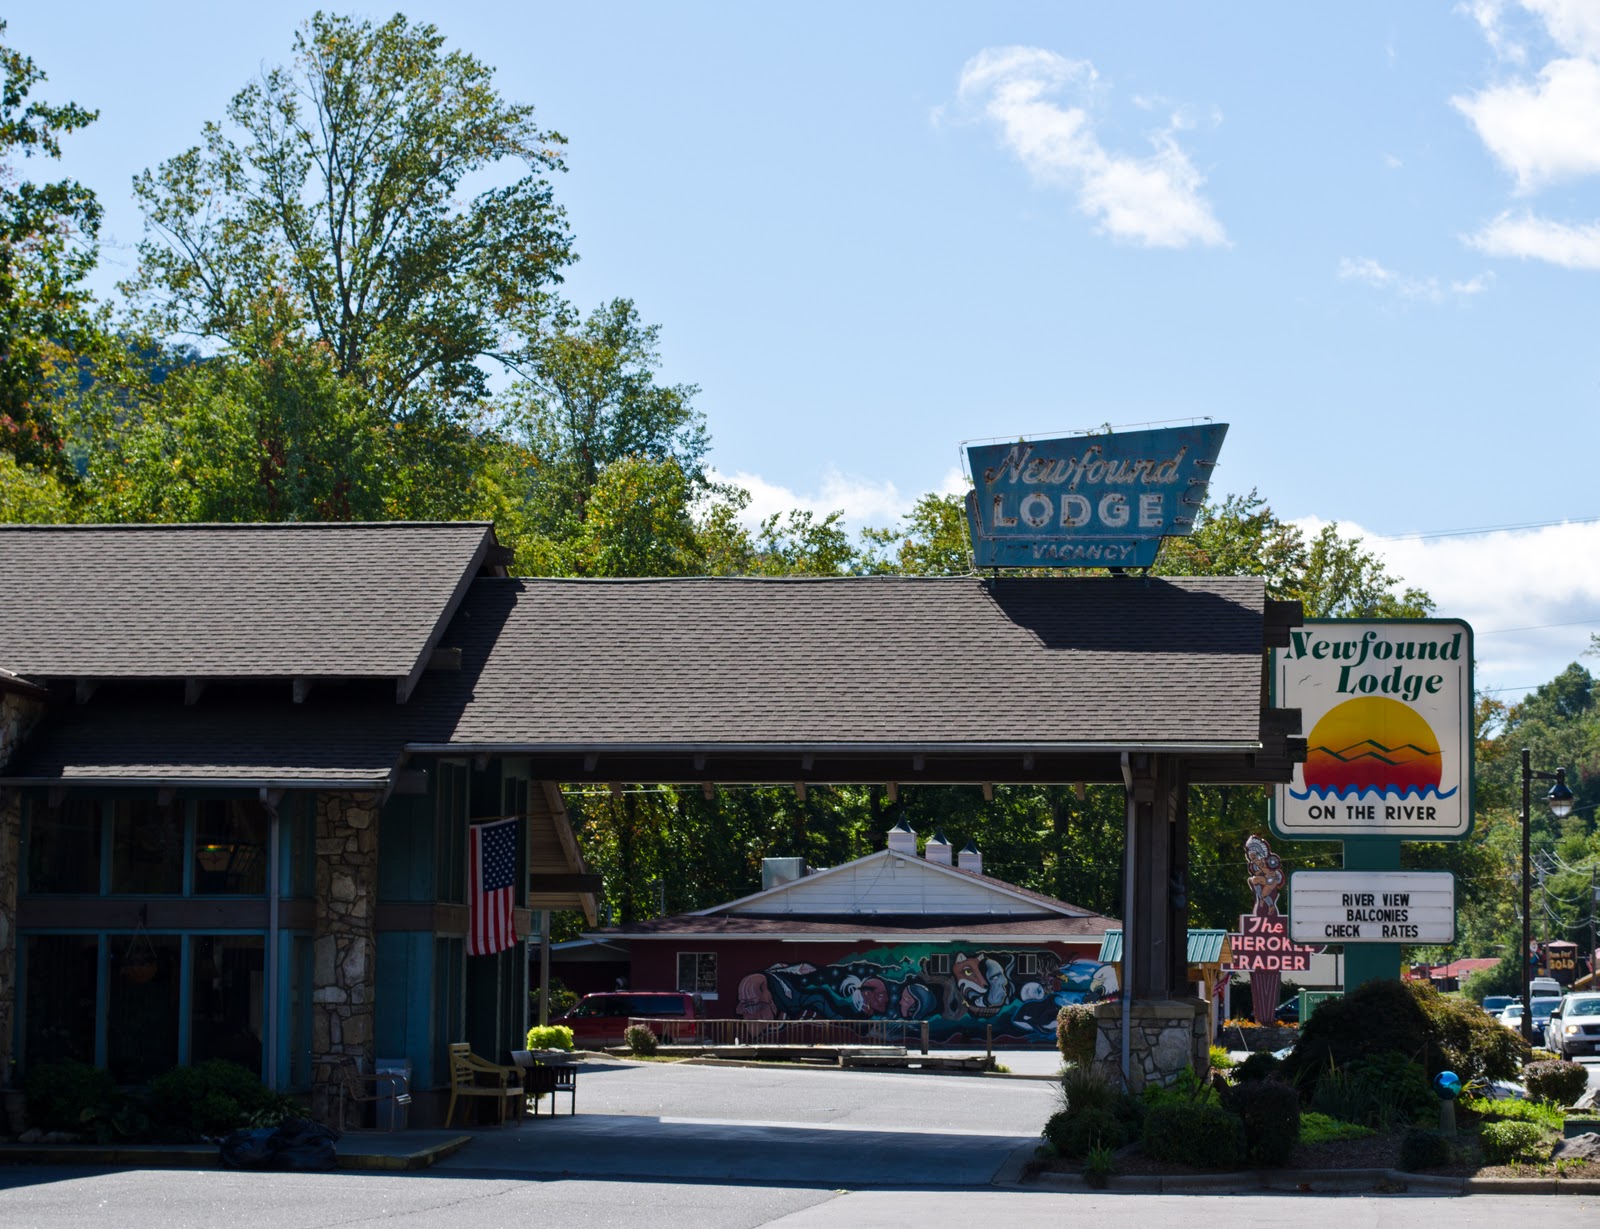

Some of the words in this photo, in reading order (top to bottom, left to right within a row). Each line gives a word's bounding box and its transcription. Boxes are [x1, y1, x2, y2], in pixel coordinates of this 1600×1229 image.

[984, 445, 1189, 491] Newfound
[993, 492, 1163, 528] LODGE
[1032, 543, 1135, 561] VACANCY
[1283, 631, 1462, 667] Newfound
[1335, 665, 1443, 701] Lodge
[1308, 805, 1336, 820] ON
[1346, 806, 1375, 820] THE
[1385, 806, 1436, 821] RIVER
[1342, 893, 1374, 906] RIVER
[1382, 893, 1410, 906] VIEW
[1346, 909, 1408, 922] BALCONIES
[1248, 916, 1284, 933] The
[1325, 924, 1360, 937] CHECK
[1382, 924, 1418, 938] RATES
[1231, 936, 1315, 952] HEROK
